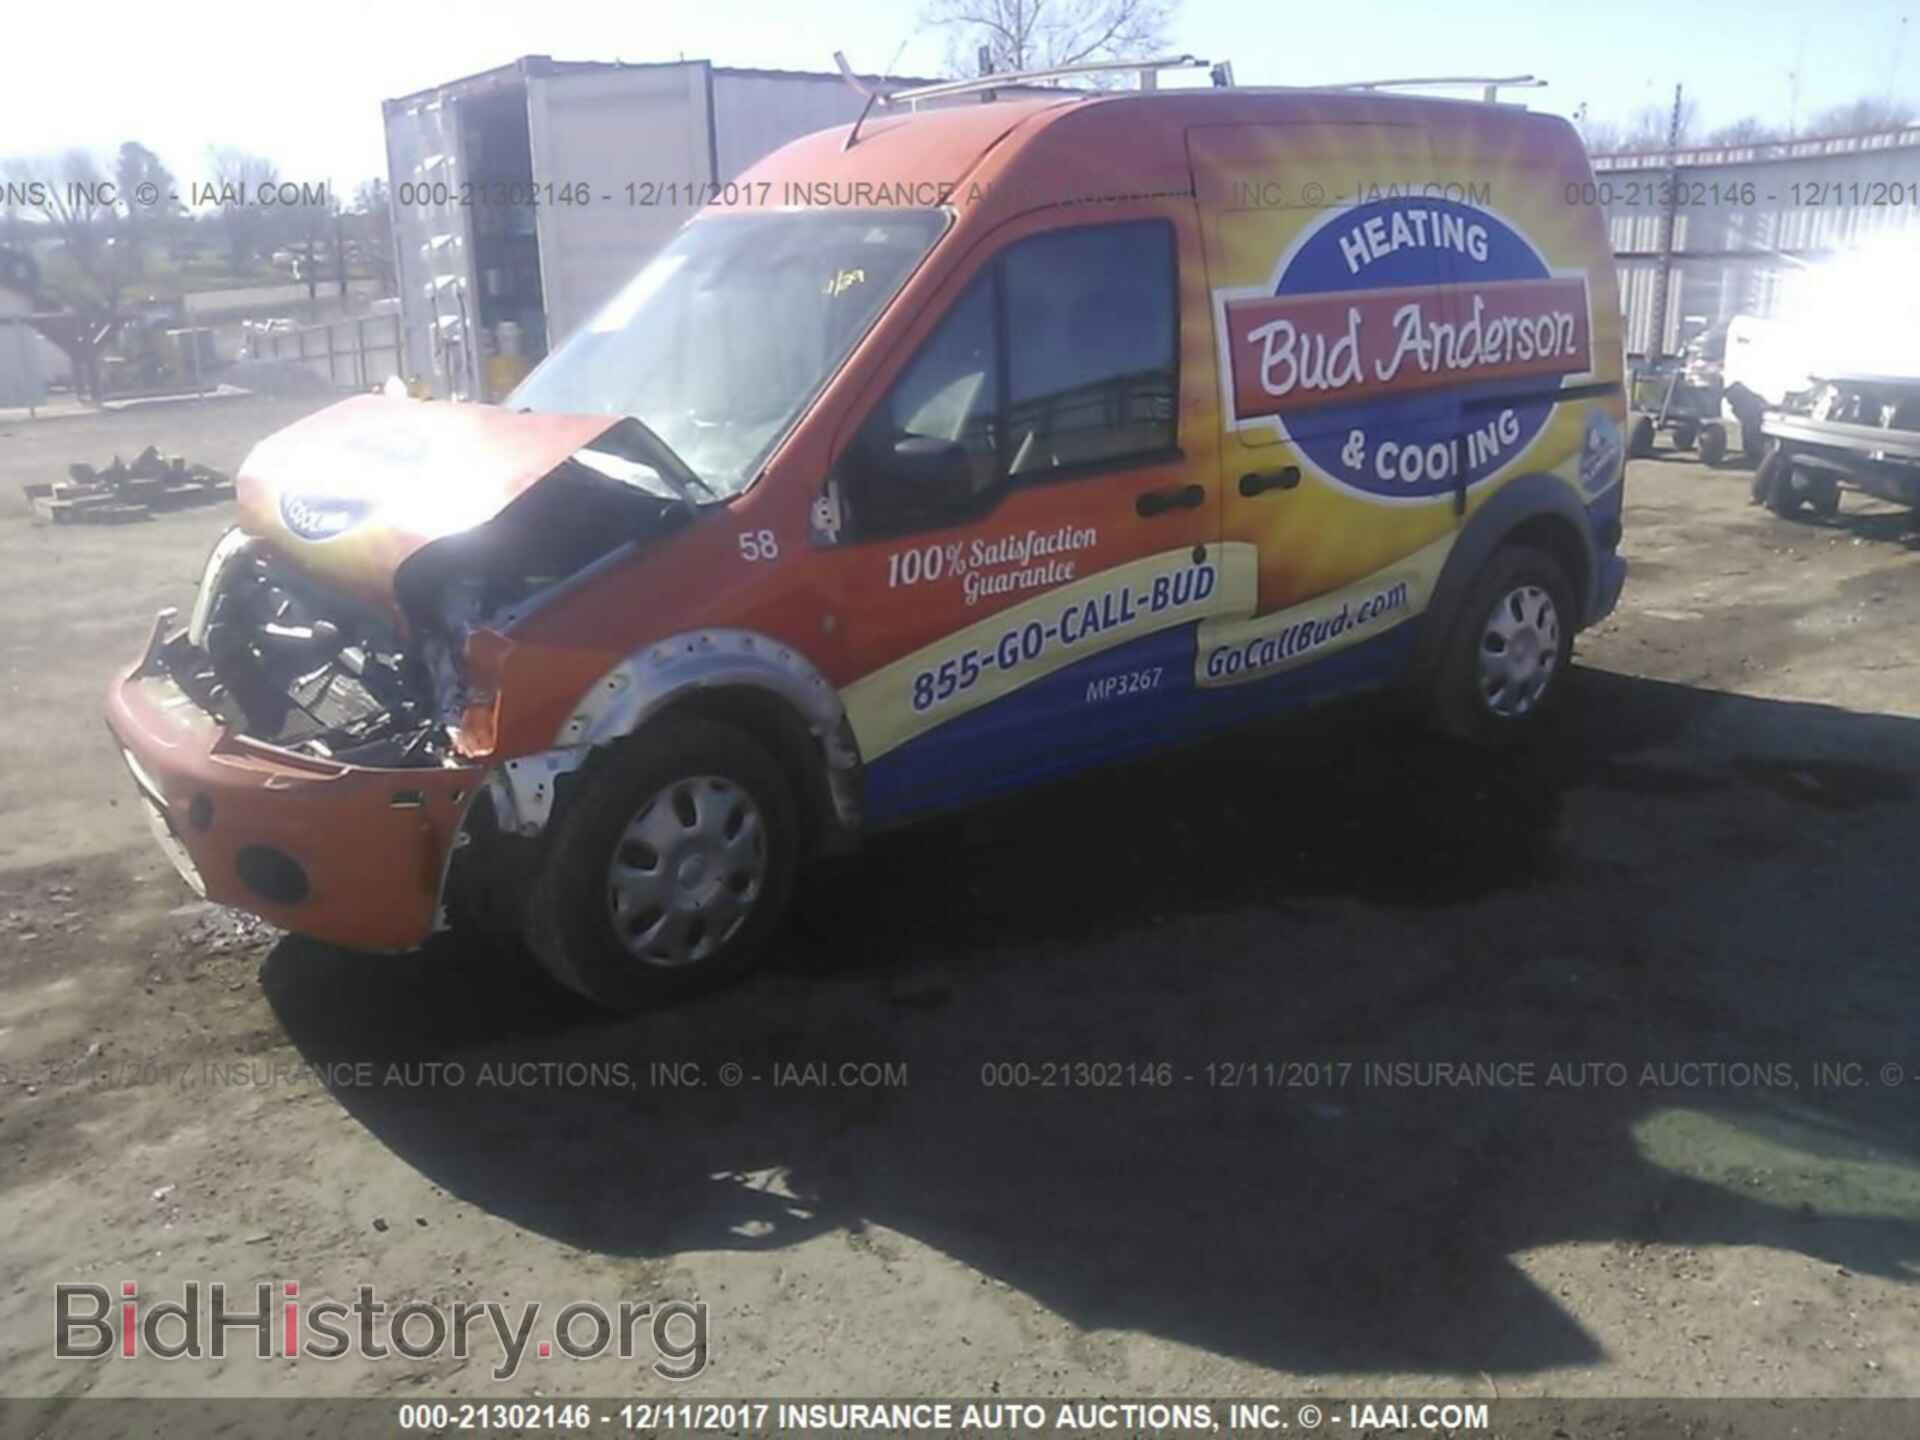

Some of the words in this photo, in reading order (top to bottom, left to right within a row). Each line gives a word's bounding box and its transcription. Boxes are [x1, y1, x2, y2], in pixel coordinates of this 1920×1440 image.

[1339, 209, 1489, 273] HEATING
[1247, 306, 1363, 396] Bud
[1375, 296, 1577, 381] Anderson
[1341, 429, 1366, 471] &
[737, 528, 779, 562] 58
[887, 541, 967, 588] 100%
[969, 524, 1098, 569] Satisfaction
[963, 558, 1076, 606] Guarantee
[911, 563, 1216, 712] 855-GO-CALL-BUD
[1207, 582, 1408, 677] GoCallBud.com
[1085, 666, 1164, 703] MP3267
